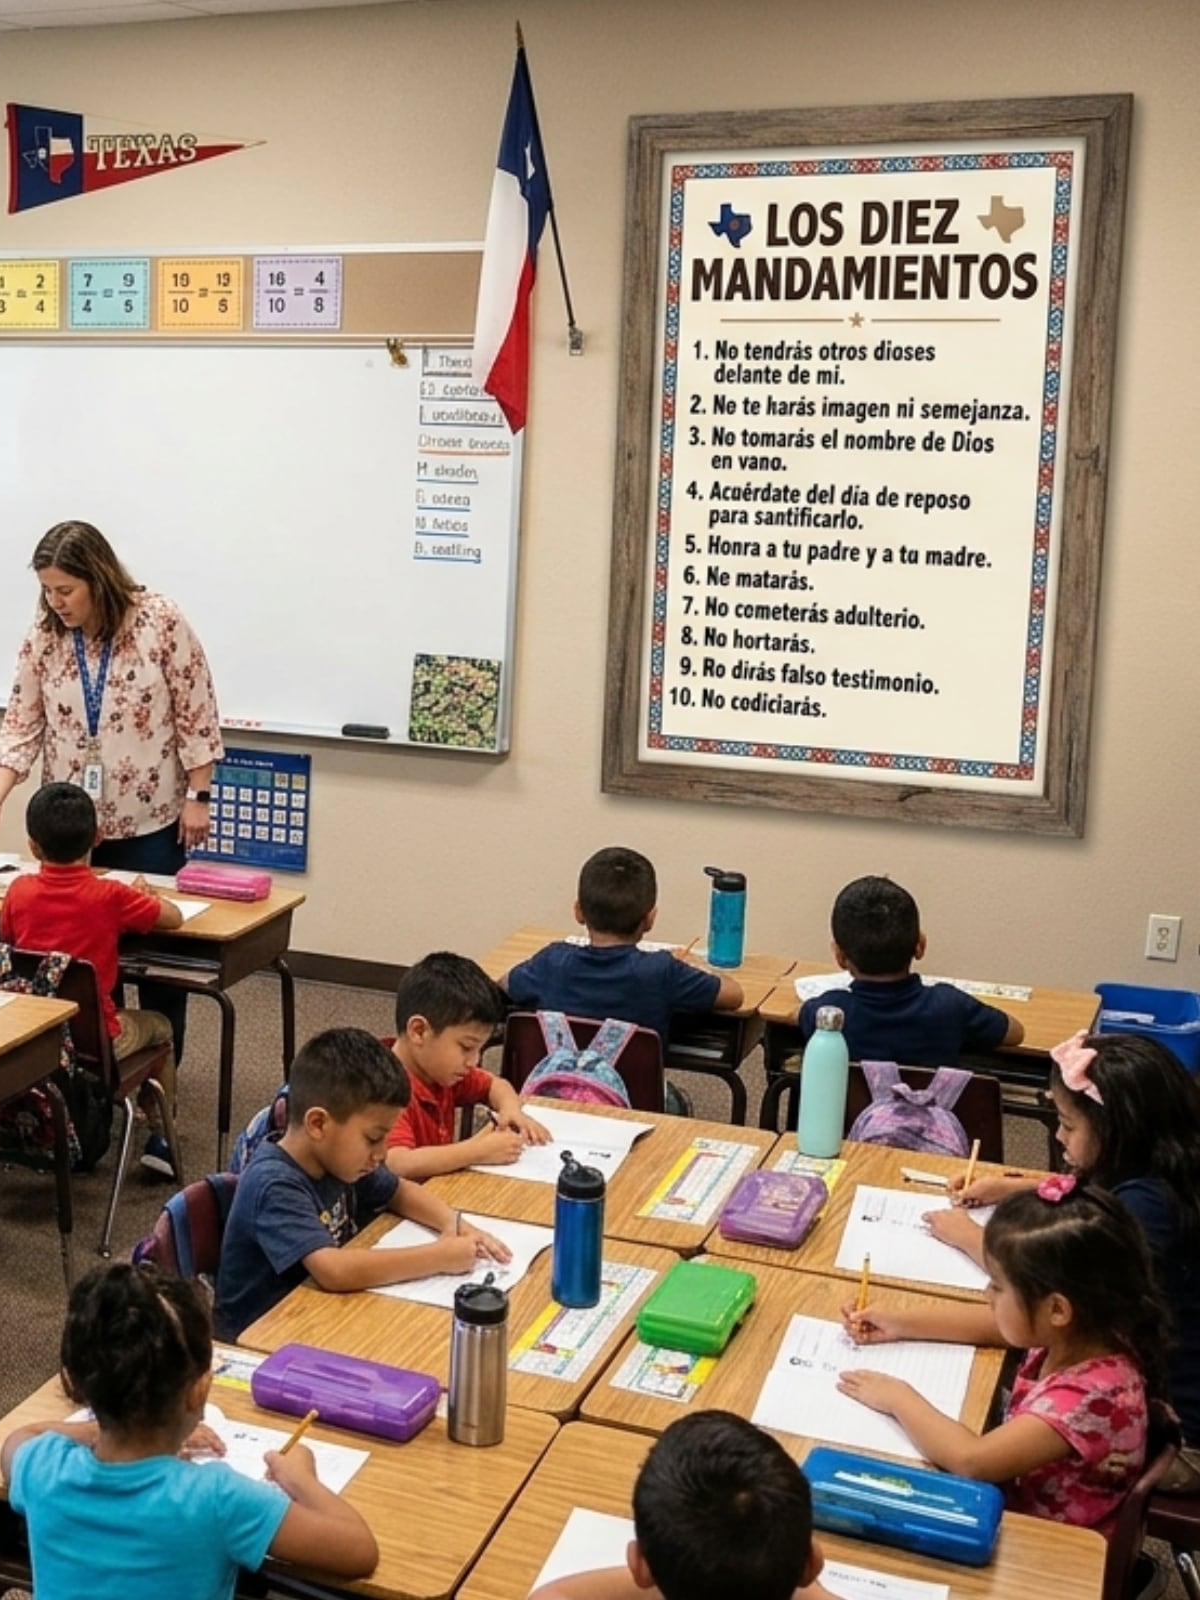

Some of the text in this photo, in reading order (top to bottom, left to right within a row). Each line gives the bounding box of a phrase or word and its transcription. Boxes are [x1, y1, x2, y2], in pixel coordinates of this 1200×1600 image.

[87, 133, 198, 171] TEXAS
[767, 199, 959, 247] LOS DIEZ
[36, 273, 45, 289] 2
[83, 273, 93, 288] 7
[314, 270, 325, 286] 4
[692, 253, 1037, 301] MANDAMIENTOS
[124, 299, 134, 314] 5
[172, 297, 190, 313] 10
[269, 296, 286, 313] 10
[695, 341, 708, 359] 1.
[716, 341, 738, 360] No
[820, 343, 867, 360] otros
[714, 363, 781, 384] delante
[788, 365, 810, 384] de
[690, 395, 706, 414] 2.
[743, 398, 760, 415] te
[767, 396, 815, 416] harás
[822, 397, 889, 423] imagen
[898, 398, 914, 417] ni
[921, 399, 1029, 425] semejanza.
[690, 426, 993, 453] 3. No tomarás el nombre de Dios
[712, 455, 786, 471] en vano.
[687, 481, 703, 500] 4.
[807, 484, 835, 504] del
[876, 486, 898, 507] de
[906, 493, 970, 514] reposo
[709, 507, 862, 529] para santificarlo.
[686, 535, 701, 553] 5.
[708, 535, 760, 556] Honra
[767, 543, 776, 557] a
[783, 540, 801, 558] tu
[807, 540, 859, 564] padre
[867, 548, 876, 568] y
[883, 548, 892, 562] a
[926, 546, 991, 567] madre.
[684, 566, 699, 584] 6.
[736, 570, 813, 590] matarás.
[683, 596, 924, 629] 7. No cometerás adulterio.
[681, 626, 697, 645] 8.
[705, 627, 727, 647] No
[680, 657, 696, 676] 9.
[732, 660, 775, 681] dirás
[782, 663, 826, 685] falso
[832, 669, 938, 694] testimonio.
[671, 687, 826, 717] 10. No codiciarás.
